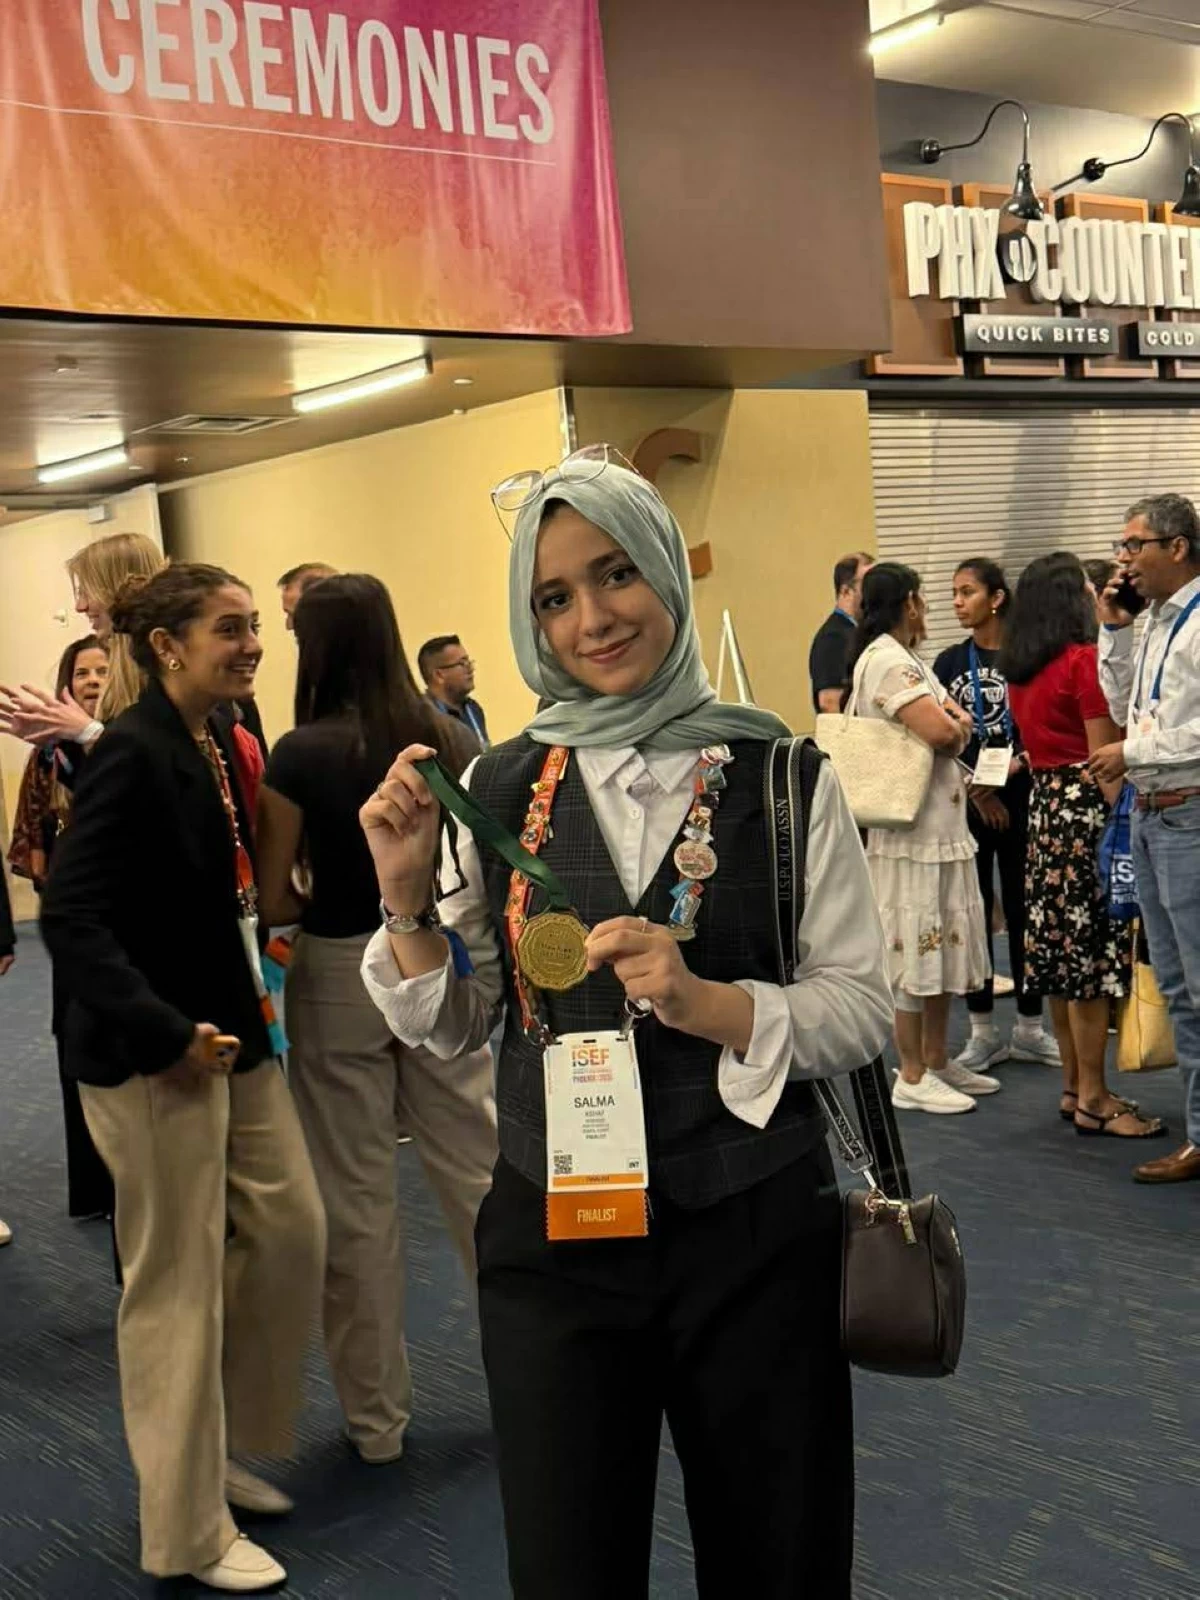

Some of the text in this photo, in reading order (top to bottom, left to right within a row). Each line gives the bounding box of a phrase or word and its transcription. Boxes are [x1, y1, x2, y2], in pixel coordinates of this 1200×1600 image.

[81, 0, 555, 145] CEREMONIES
[904, 201, 1007, 300] PHX
[977, 325, 1111, 344] QUICK BITES
[1147, 331, 1195, 346] COLD
[572, 1048, 609, 1067] ISEF
[574, 1095, 616, 1109] SALMA
[577, 1207, 618, 1224] FINALIST
